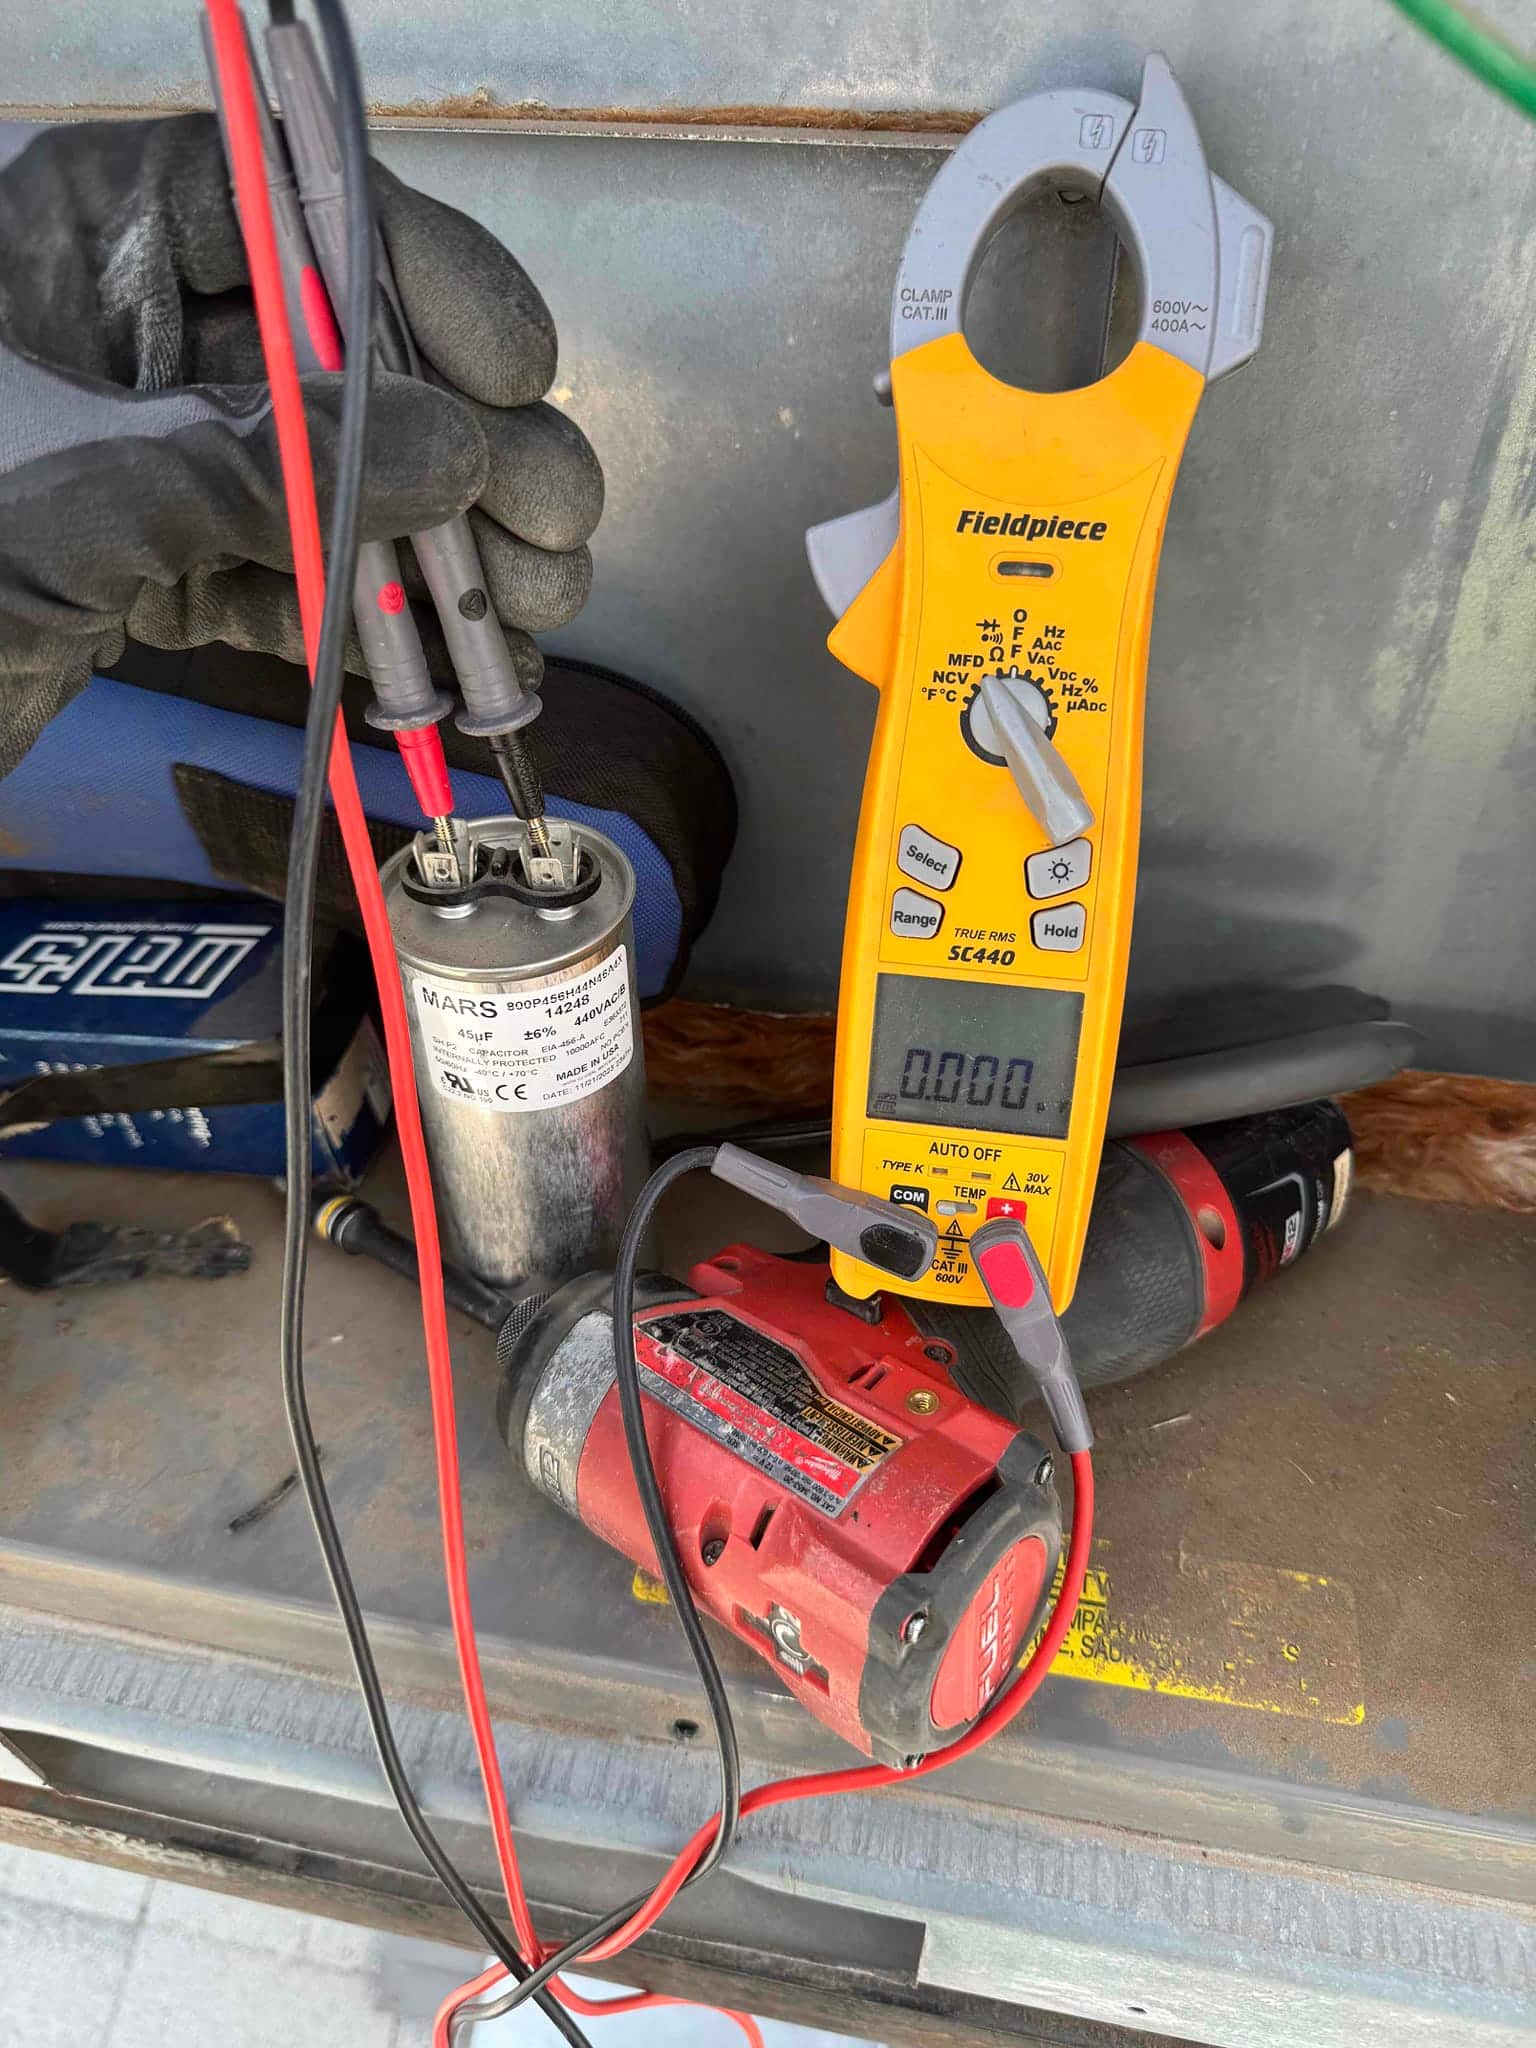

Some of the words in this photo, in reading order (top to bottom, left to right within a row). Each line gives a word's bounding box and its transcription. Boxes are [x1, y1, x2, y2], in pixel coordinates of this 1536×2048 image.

[900, 288, 953, 302] CLAMP
[902, 306, 948, 321] CAT.III
[956, 510, 1107, 541] Fieldpiece
[1044, 625, 1065, 638] Hz
[948, 654, 984, 668] MFD
[932, 670, 969, 684] NCV
[1061, 684, 1082, 697] Hz
[1082, 678, 1098, 693] %
[905, 844, 948, 875] Select
[893, 910, 937, 928] Range
[953, 927, 986, 940] TRUE
[988, 929, 1017, 943] RMS
[1043, 923, 1079, 939] Hold
[948, 945, 1016, 966] SC440
[422, 986, 498, 1018] MARS
[545, 994, 590, 1018] 14248
[523, 1025, 557, 1041] ±6%
[468, 1047, 529, 1058] CAPACITOR
[492, 1054, 557, 1068] PROTECTED
[556, 1063, 588, 1081] MADE
[590, 1056, 601, 1068] IN
[602, 1043, 620, 1060] USA
[900, 1048, 1034, 1110] 0.000
[929, 1141, 970, 1159] AUTO
[973, 1147, 1003, 1162] OFF
[881, 1159, 912, 1173] TYPE
[914, 1163, 924, 1174] K
[1026, 1171, 1049, 1184] 30V
[893, 1189, 925, 1203] COM
[953, 1185, 987, 1200] TEMP
[1023, 1183, 1052, 1196] MAX
[931, 1258, 955, 1273] CAT
[957, 1261, 968, 1274] III
[935, 1271, 964, 1285] 600V
[826, 1402, 885, 1441] ADVERTENCIA
[817, 1432, 858, 1467] WARNING
